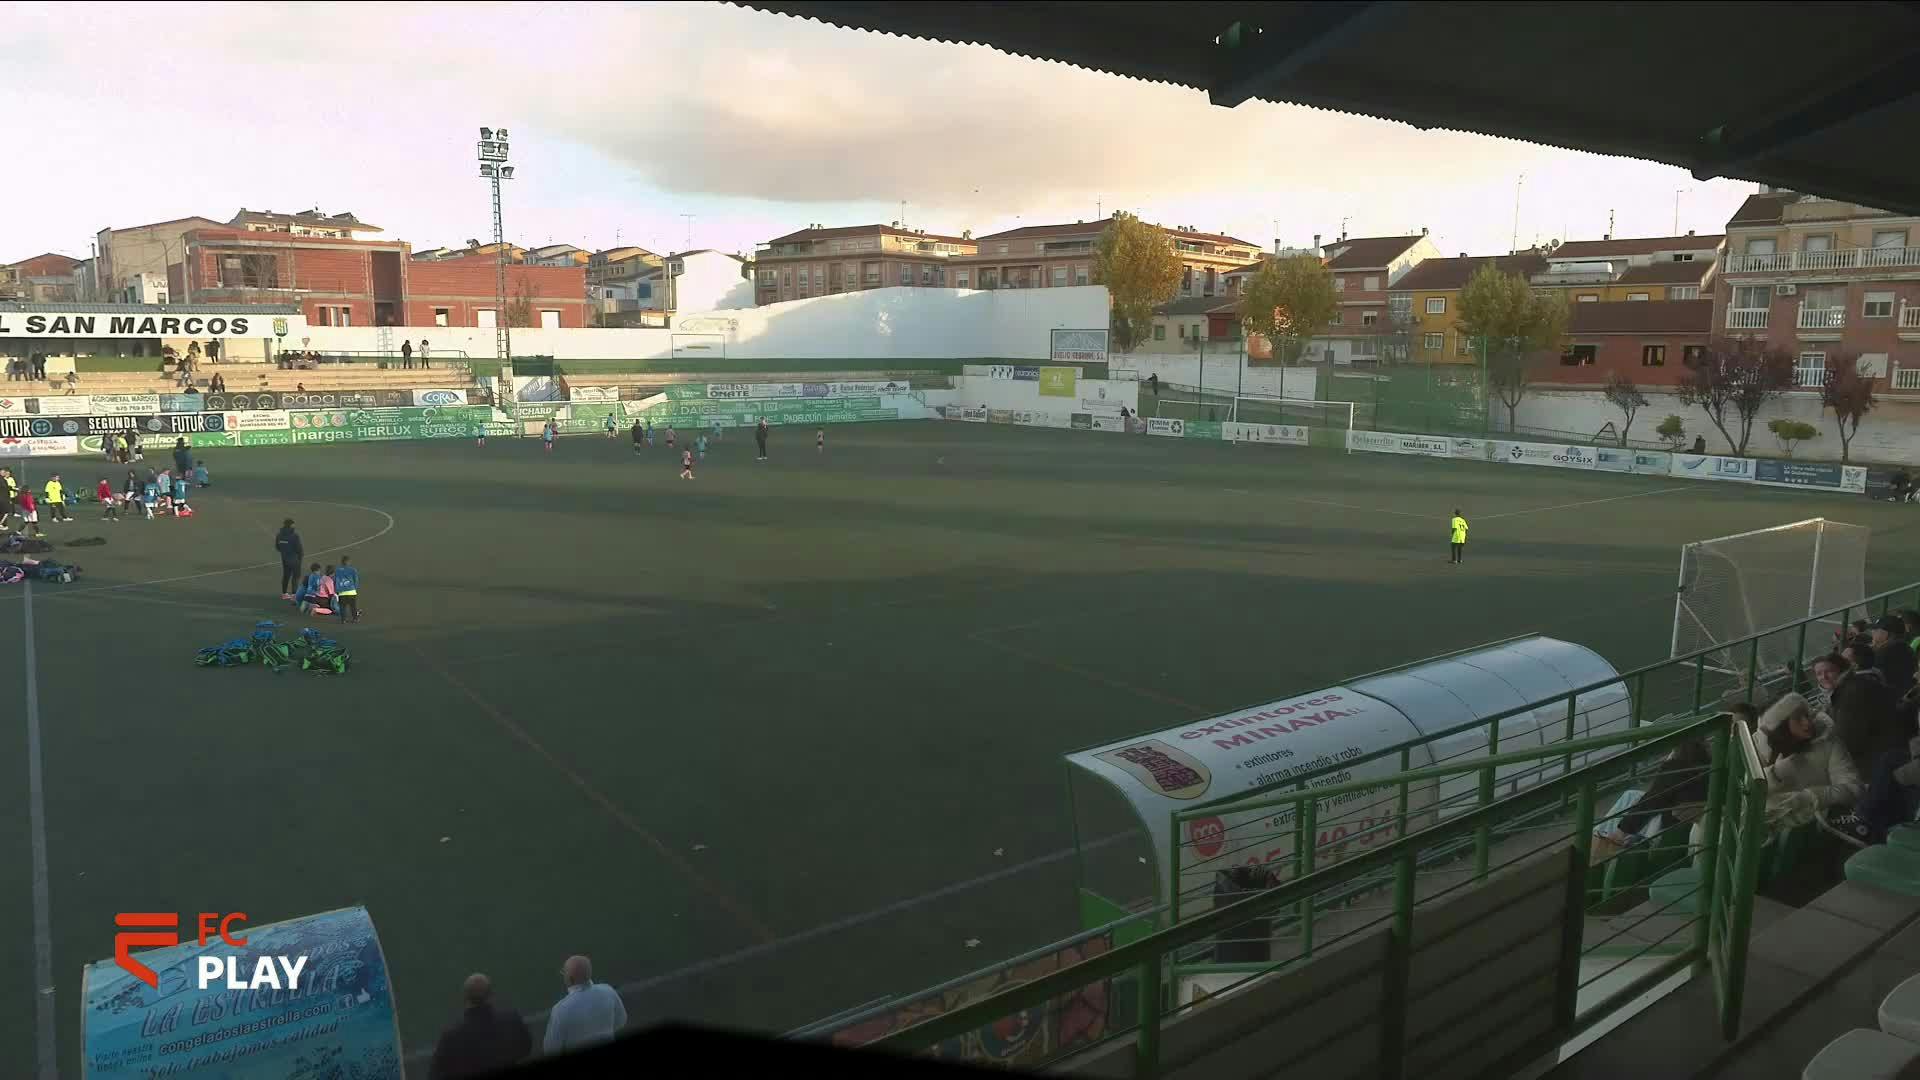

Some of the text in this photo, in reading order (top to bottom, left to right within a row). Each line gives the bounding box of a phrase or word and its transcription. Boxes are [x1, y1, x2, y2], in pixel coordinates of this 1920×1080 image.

[25, 315, 95, 334] SAN
[109, 316, 248, 335] MARCOS
[426, 391, 458, 404] CORAL
[88, 417, 138, 430] SEGUNDA
[357, 424, 412, 437] HERLUX
[1552, 453, 1593, 464] GOYSIX
[1179, 692, 1344, 740] extintores
[1212, 708, 1349, 750] MINAYA
[1243, 748, 1295, 770] extintores
[1256, 746, 1362, 786] alarma incendio y robo
[1311, 770, 1352, 790] incendio
[140, 1003, 184, 1038] LA
[159, 1002, 331, 1056] congeladoslaestrella.com
